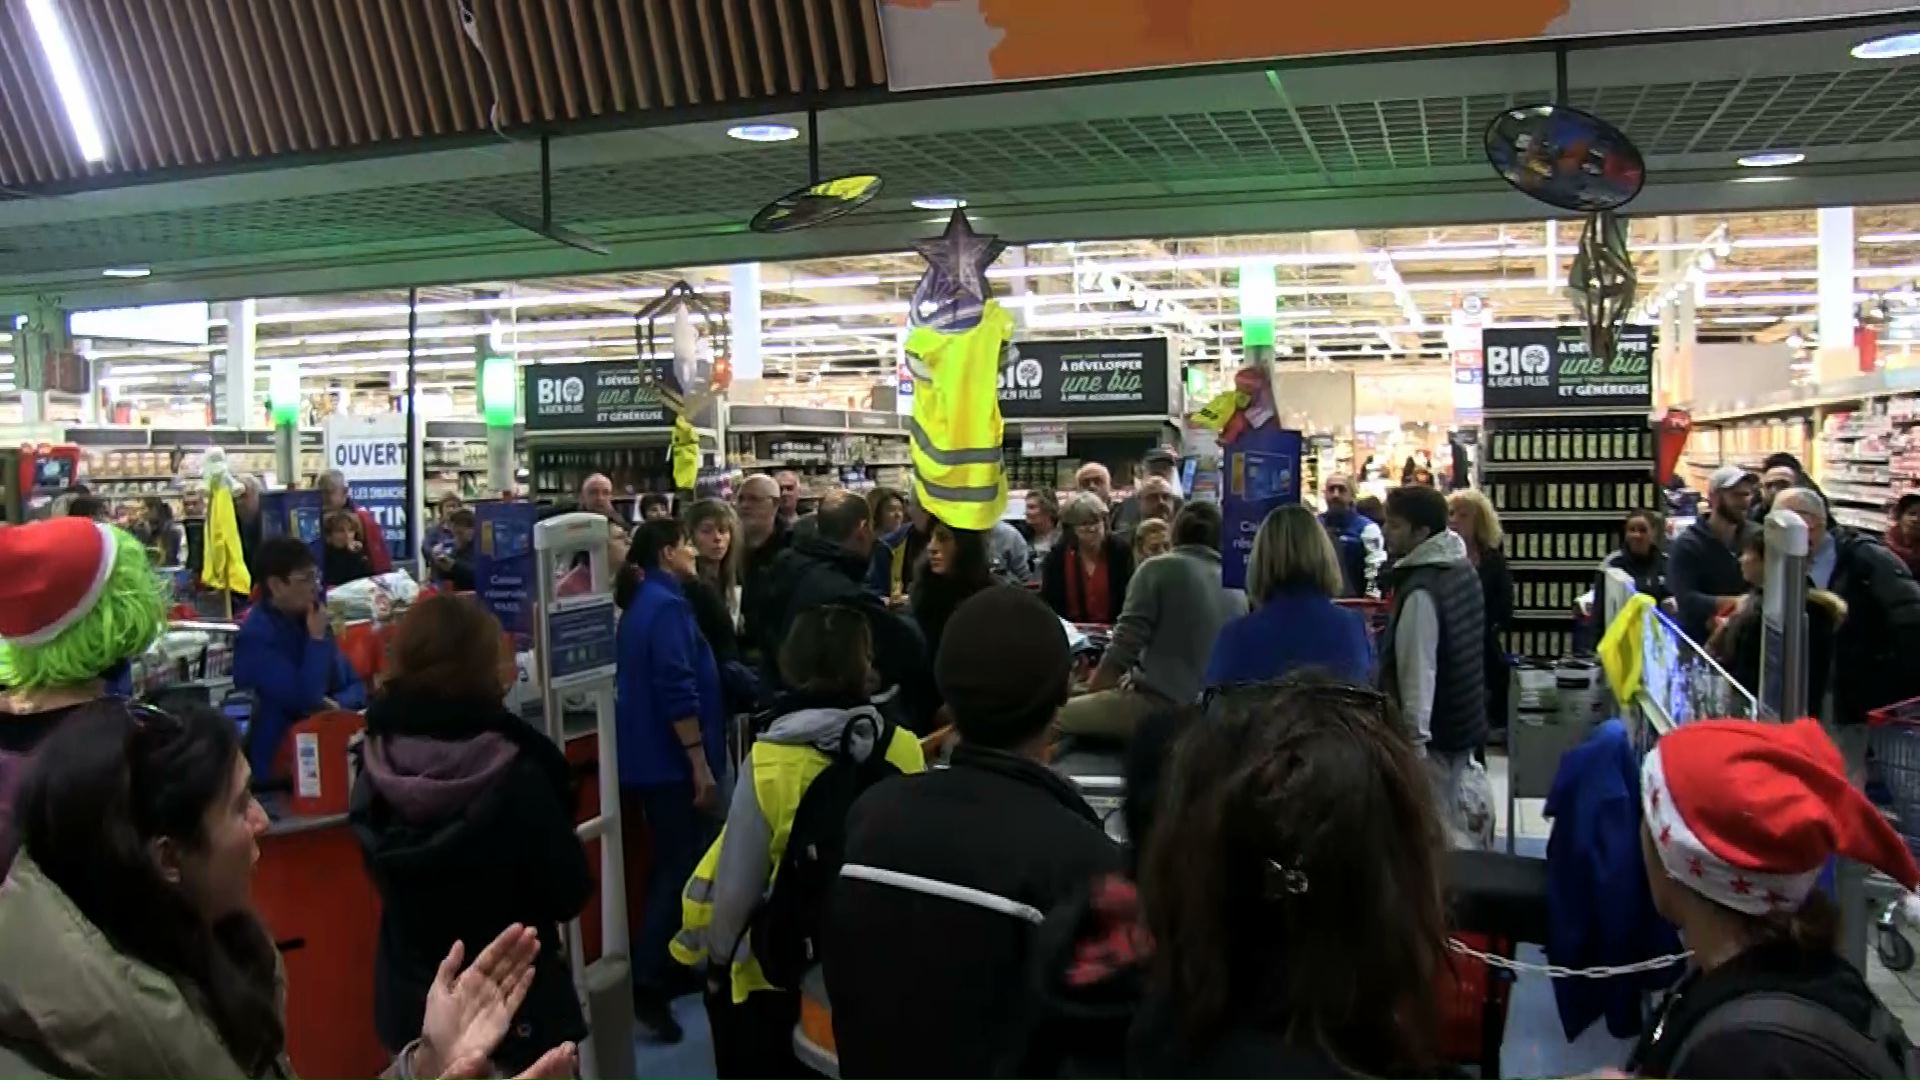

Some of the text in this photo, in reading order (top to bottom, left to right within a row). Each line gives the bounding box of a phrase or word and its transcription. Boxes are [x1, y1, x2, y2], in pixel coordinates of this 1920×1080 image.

[1070, 359, 1143, 372] DÉVELOPPER
[1487, 344, 1550, 375] BIO
[1558, 350, 1648, 375] une bio
[538, 376, 585, 404] BIO
[1060, 367, 1143, 393] une bio
[336, 443, 406, 465] OUVERT
